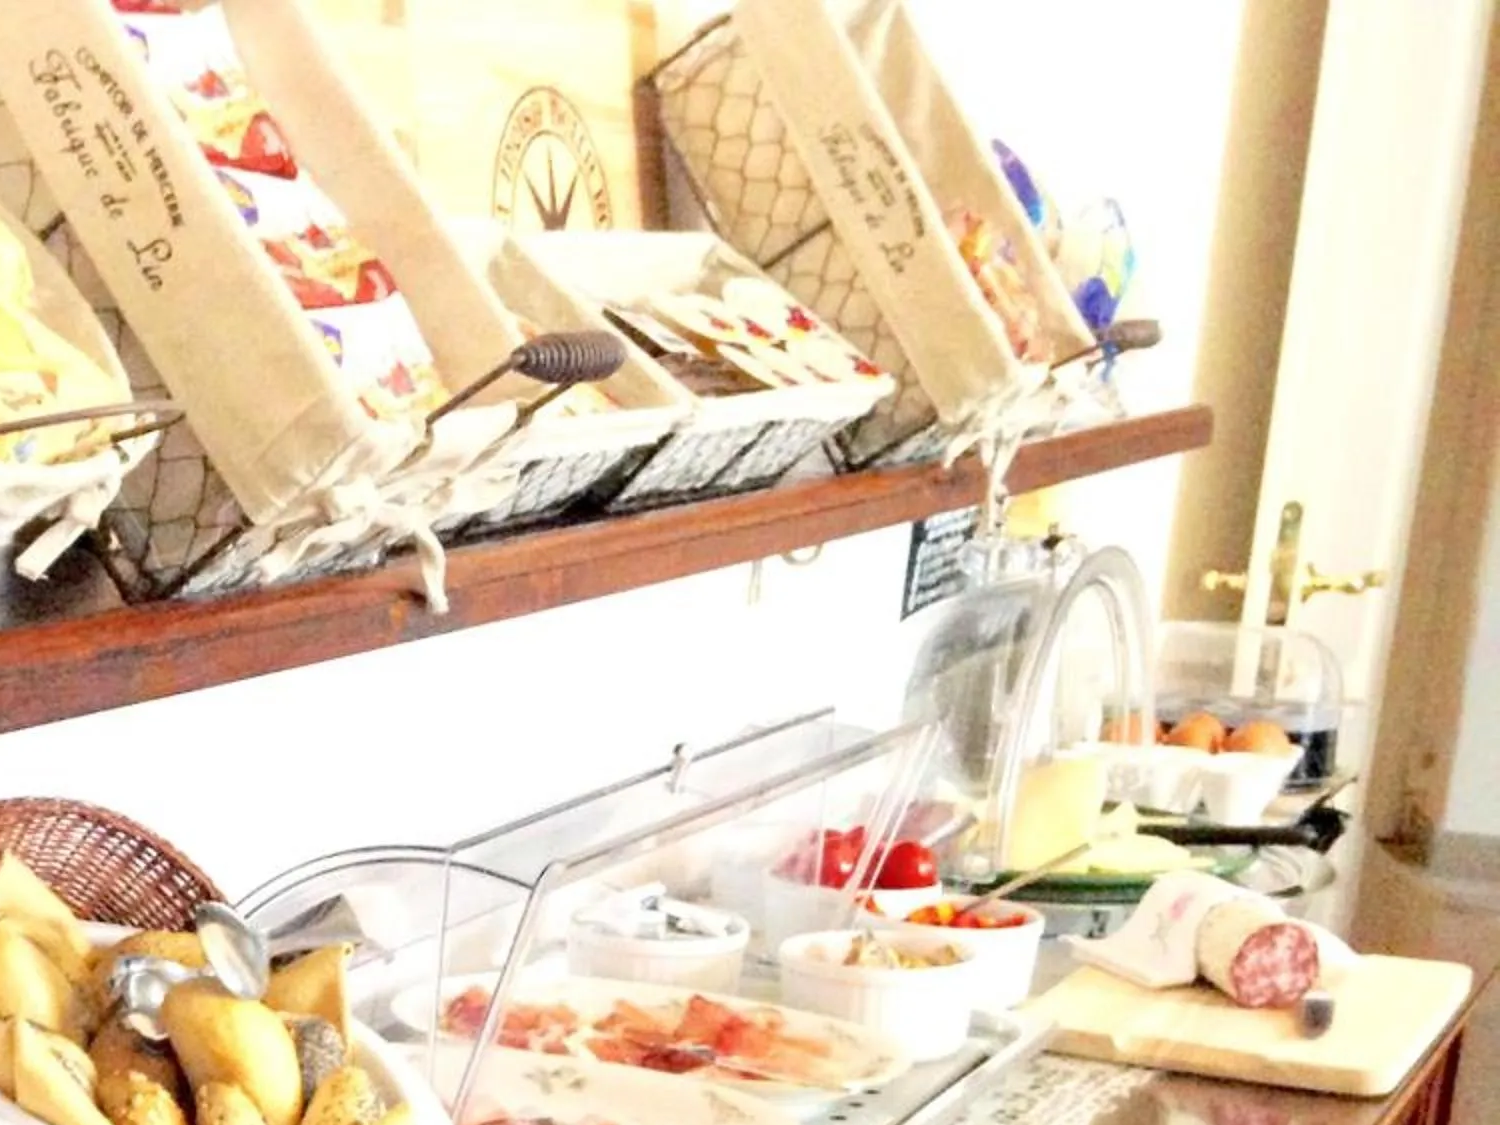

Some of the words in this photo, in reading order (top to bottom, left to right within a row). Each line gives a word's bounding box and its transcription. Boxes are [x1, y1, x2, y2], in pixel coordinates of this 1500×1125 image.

[27, 48, 100, 180] Fabrique
[100, 193, 130, 220] de
[126, 237, 174, 292] Lin
